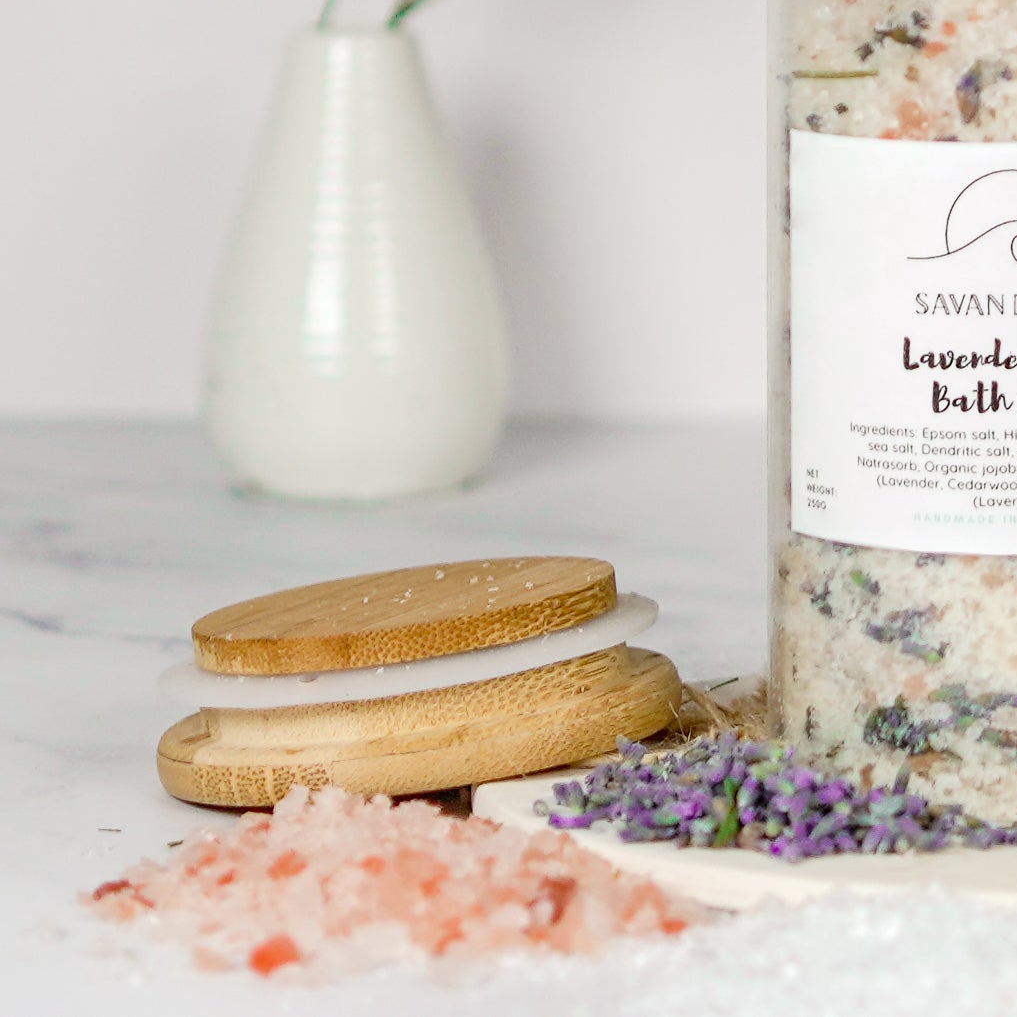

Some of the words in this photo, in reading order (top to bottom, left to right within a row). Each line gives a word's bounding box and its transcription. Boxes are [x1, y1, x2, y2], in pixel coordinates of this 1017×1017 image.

[915, 291, 1005, 315] SAVAN
[931, 380, 1014, 413] Bath
[850, 422, 917, 438] Ingredients:
[923, 428, 966, 441] Epsom
[972, 430, 999, 441] salt,
[868, 443, 888, 452] sea
[893, 443, 917, 455] salt,
[922, 444, 981, 456] Dendritic
[986, 445, 1013, 457] salt,
[857, 456, 920, 472] Natrasorb,
[925, 461, 977, 475] Organic
[807, 469, 819, 478] NET
[876, 475, 944, 490] (Lavender,
[807, 484, 837, 496] WEIGHT:
[807, 499, 827, 510] 250G
[914, 513, 995, 524] HANDMADE
[1002, 514, 1017, 524] IN
